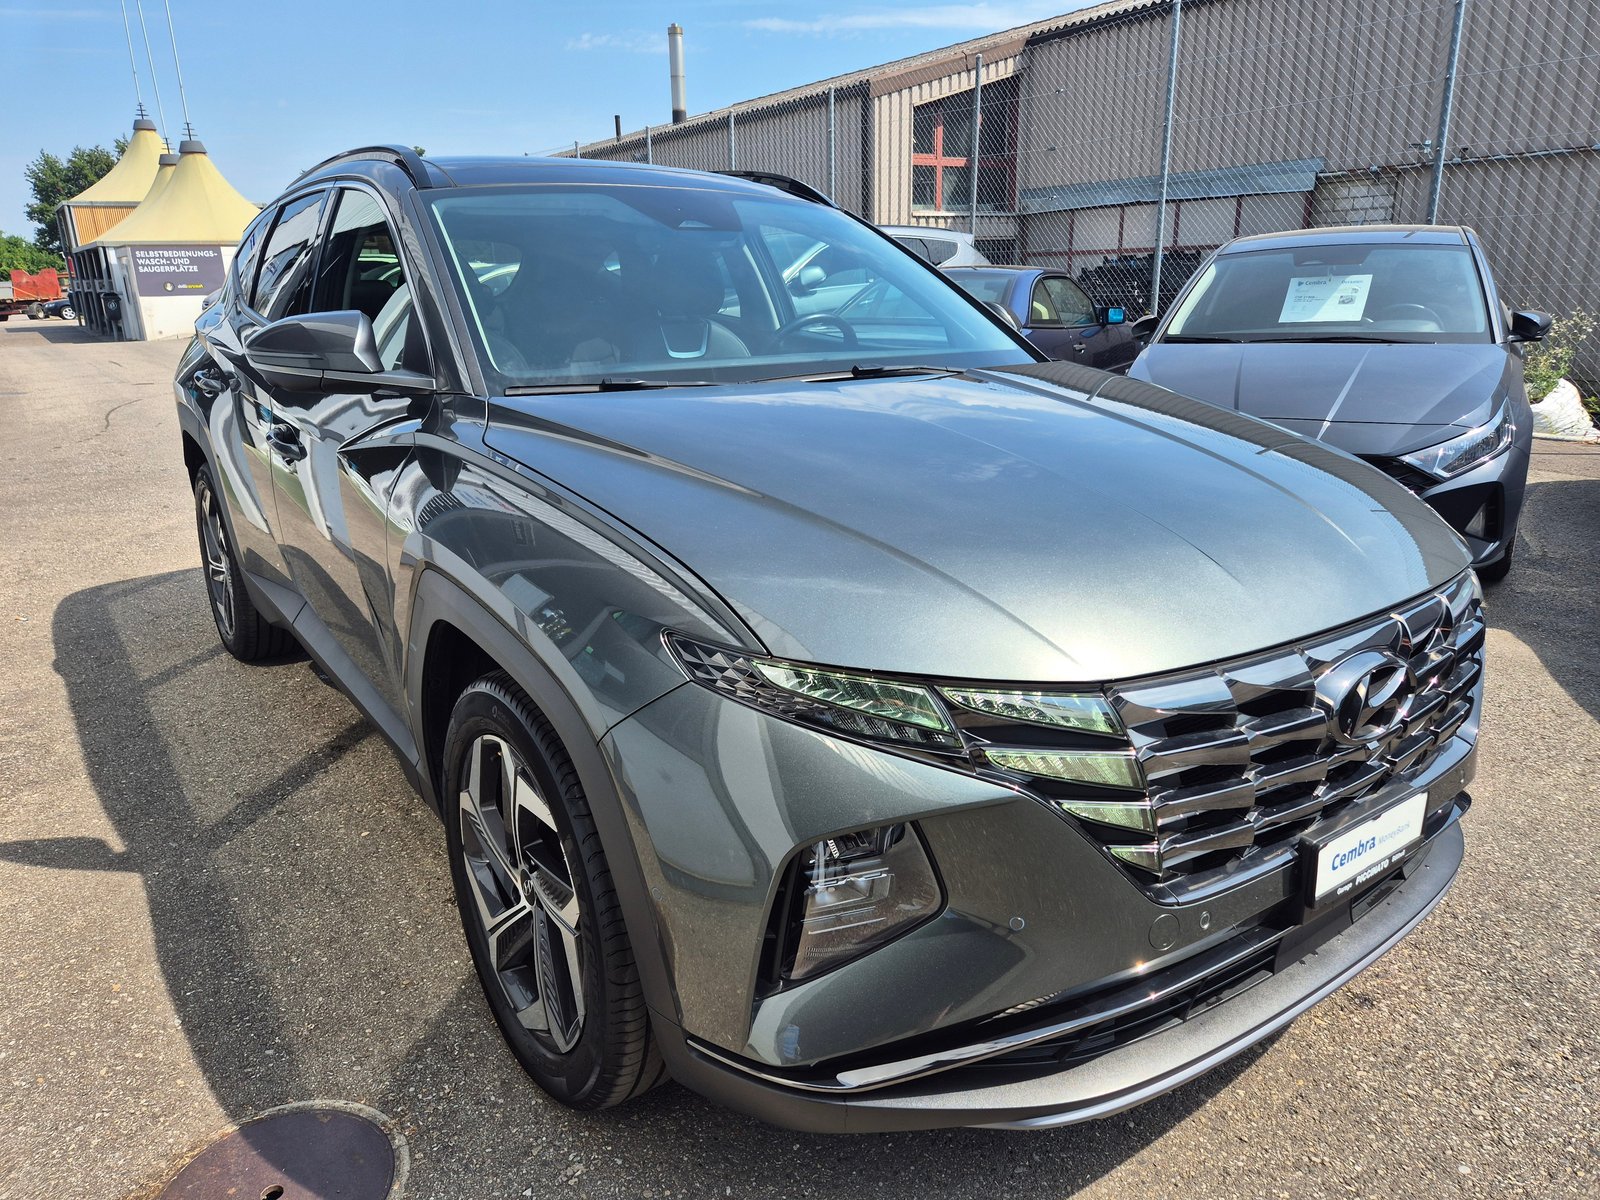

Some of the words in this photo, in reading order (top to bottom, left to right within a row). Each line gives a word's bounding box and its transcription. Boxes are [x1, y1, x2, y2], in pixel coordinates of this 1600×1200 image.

[135, 250, 218, 258] SELBSTBEDIENUNGS-
[138, 264, 199, 273] SAUGERPLÄTZE
[1331, 836, 1376, 871] Cembra
[1378, 821, 1411, 844] MoneyBank
